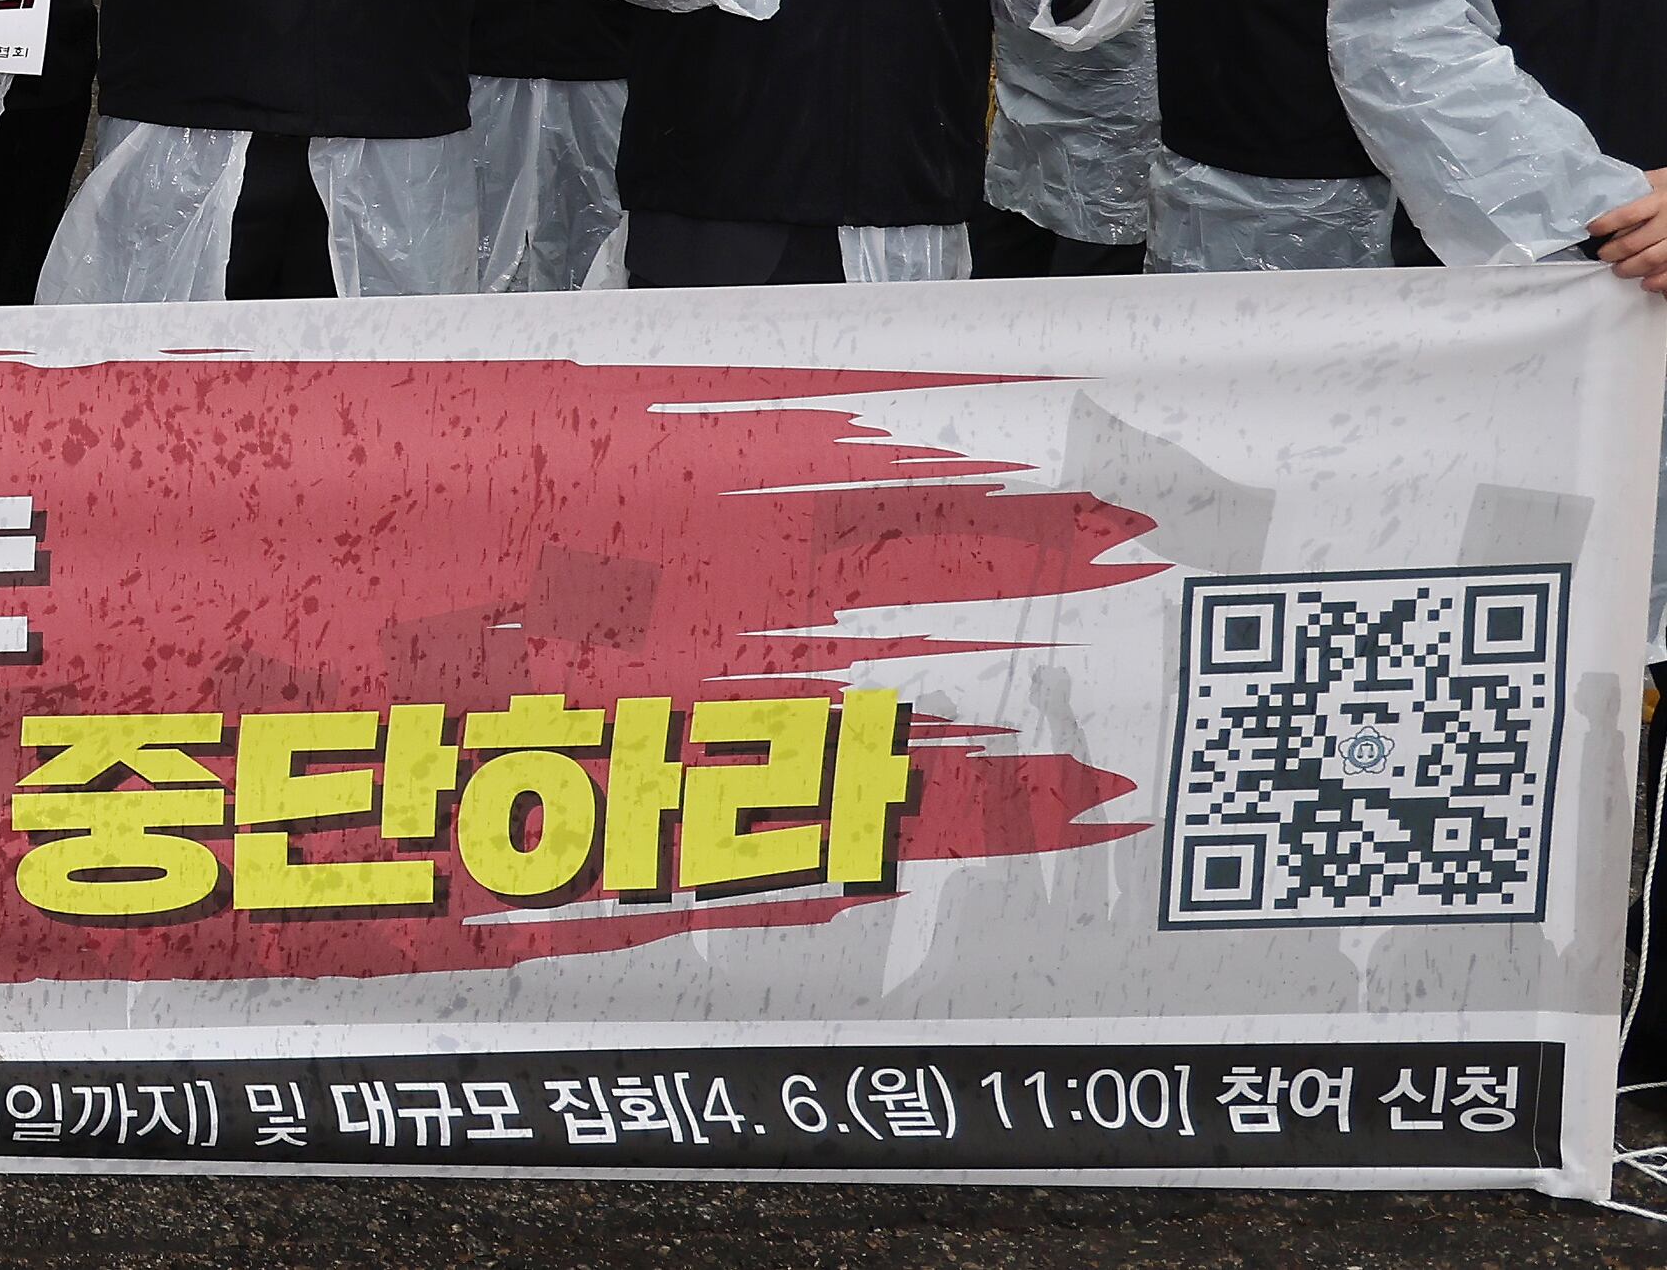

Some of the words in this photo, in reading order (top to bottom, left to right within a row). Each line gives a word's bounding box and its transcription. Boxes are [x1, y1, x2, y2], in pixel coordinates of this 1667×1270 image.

[8, 684, 910, 921] 중단하라
[243, 1081, 309, 1147] 및
[337, 1079, 535, 1149] 대규모
[980, 1063, 1196, 1138] 11:00]
[1216, 1063, 1355, 1137] 참여
[1377, 1063, 1522, 1133] 신청
